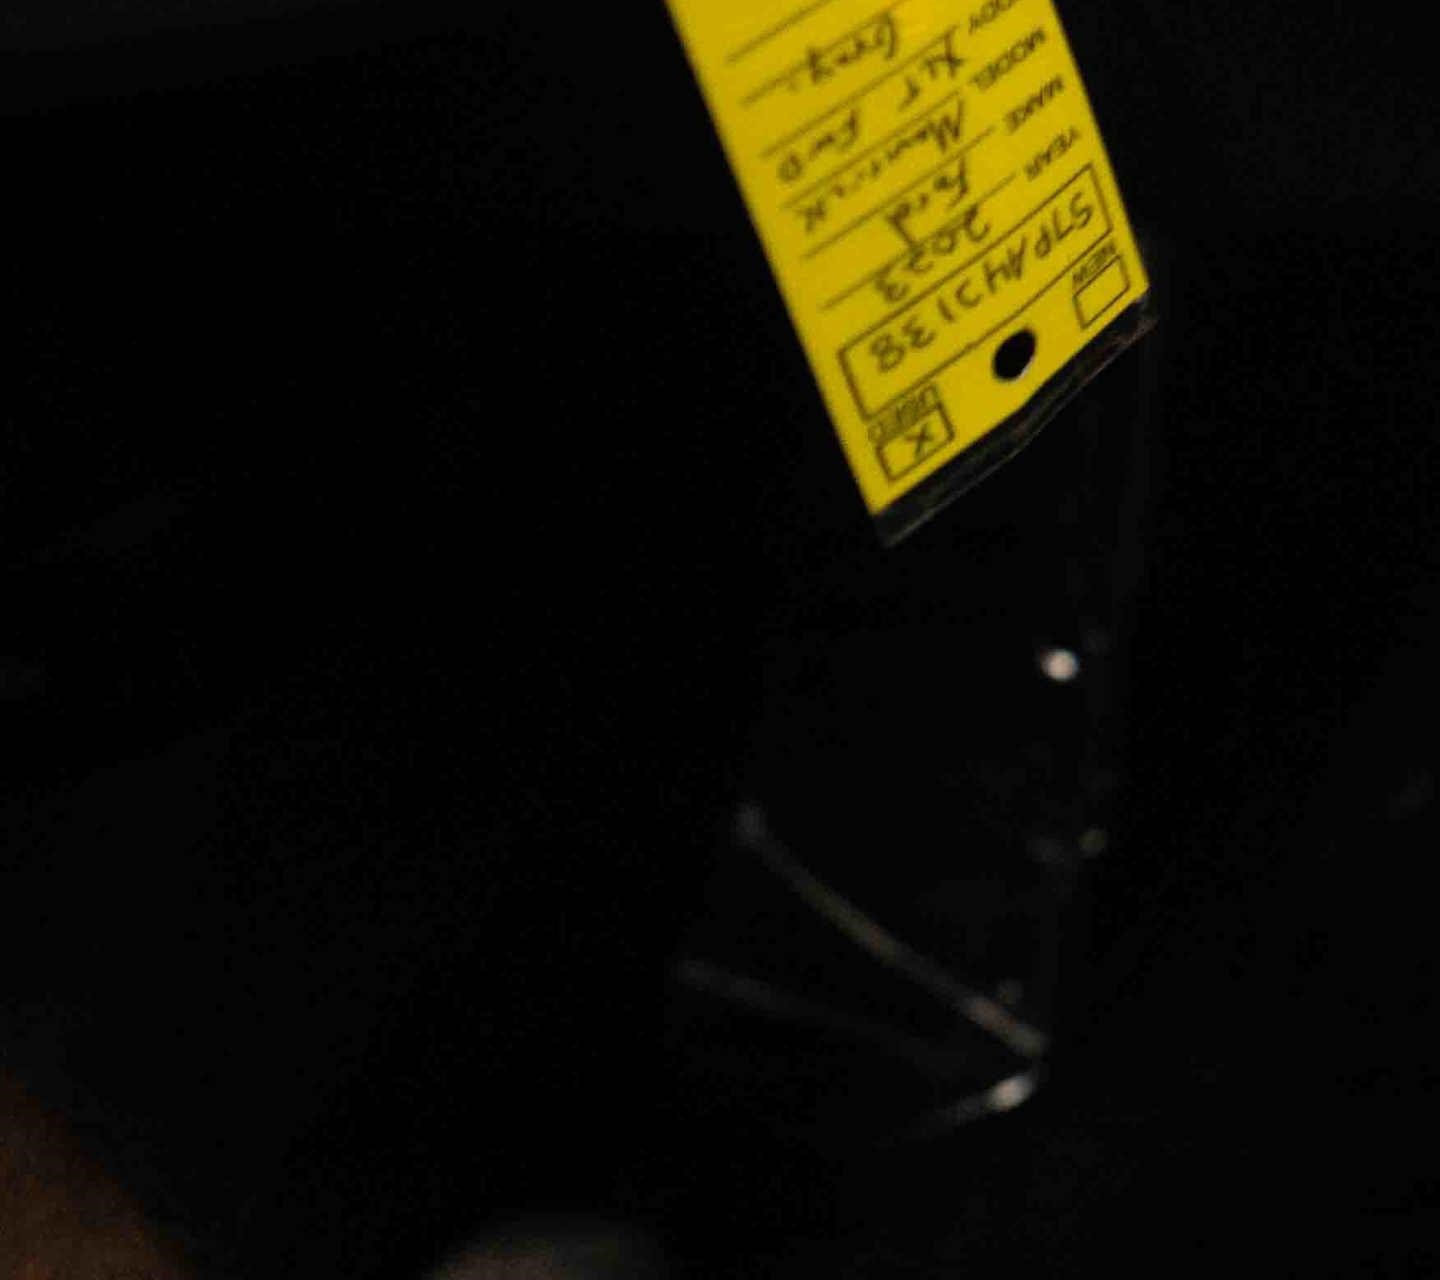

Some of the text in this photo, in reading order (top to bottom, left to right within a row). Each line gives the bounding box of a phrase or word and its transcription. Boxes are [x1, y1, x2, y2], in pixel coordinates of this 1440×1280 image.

[970, 27, 1047, 91] MODEL
[1003, 74, 1065, 134] MAKE
[1025, 126, 1081, 181] YEAR
[1070, 241, 1119, 288] NEW
